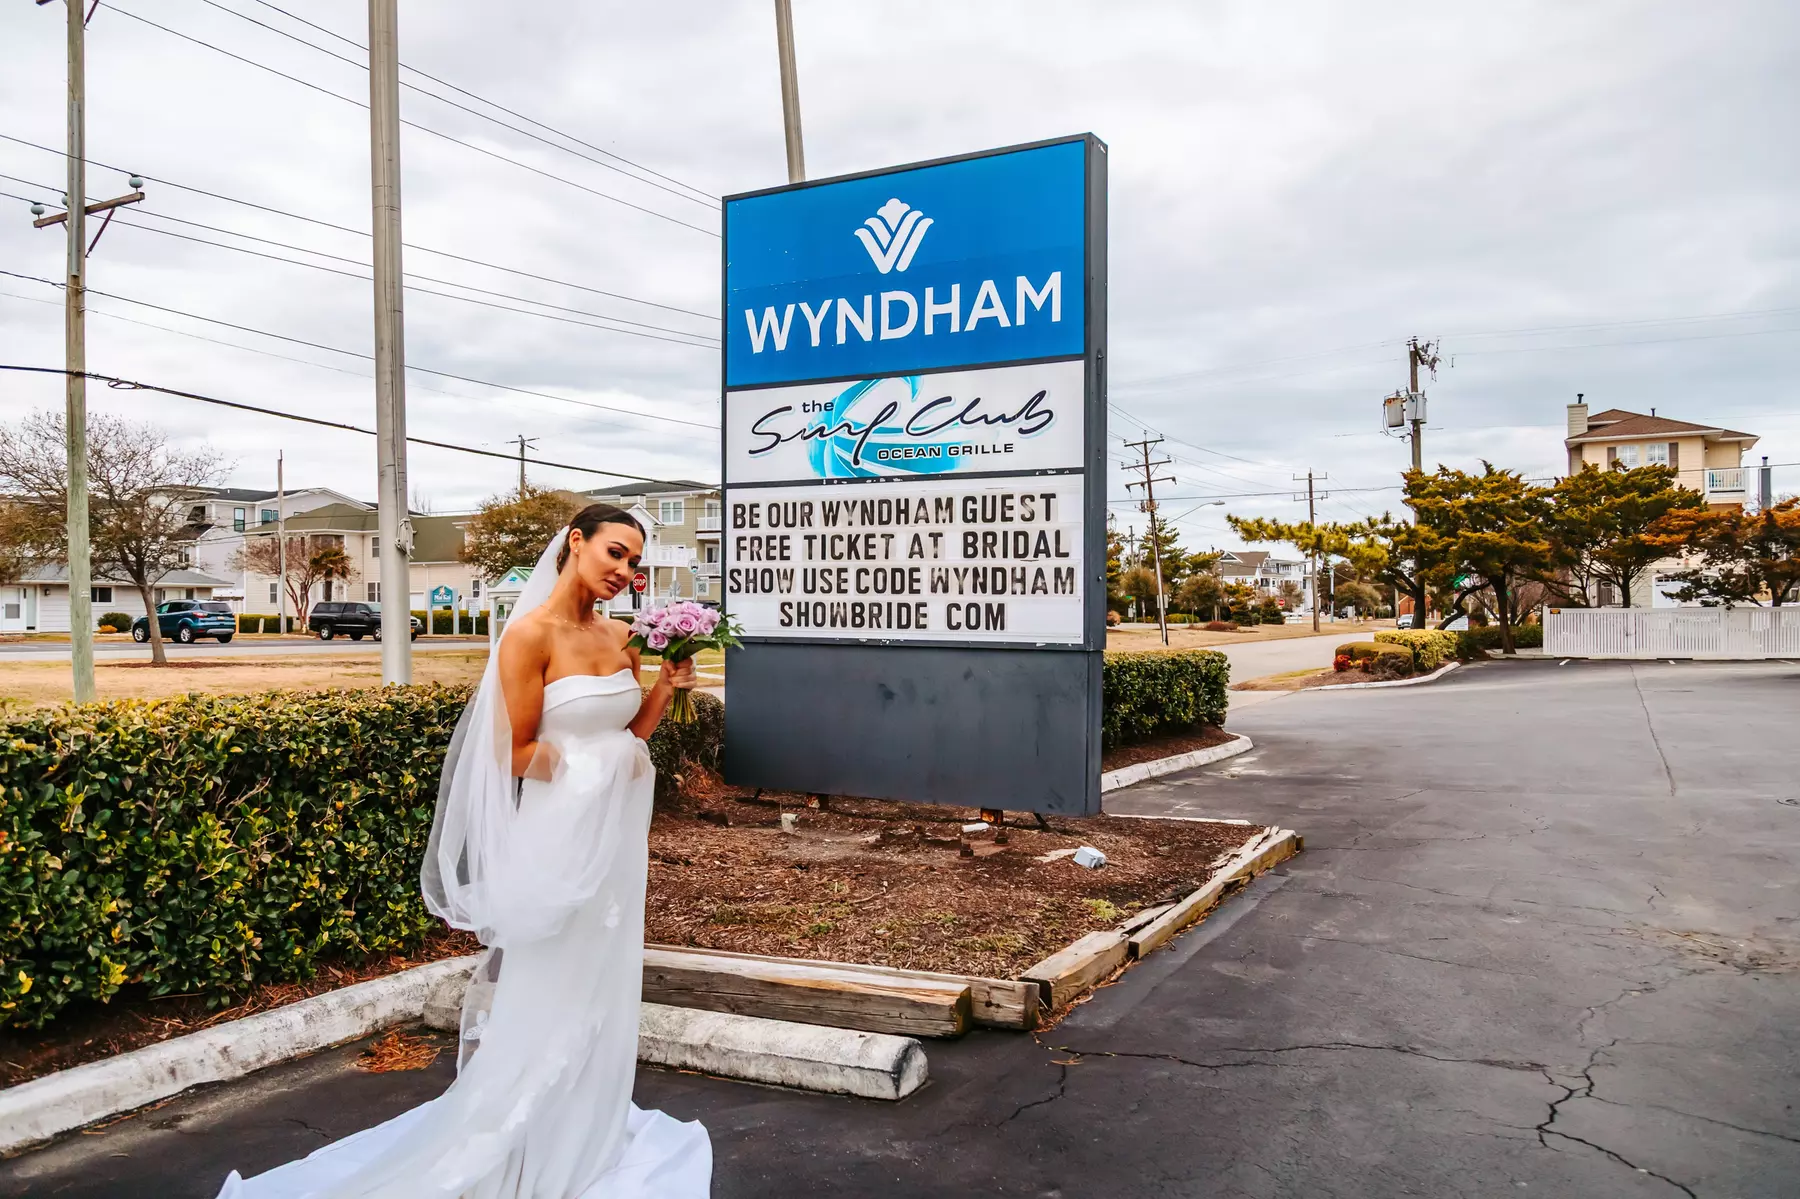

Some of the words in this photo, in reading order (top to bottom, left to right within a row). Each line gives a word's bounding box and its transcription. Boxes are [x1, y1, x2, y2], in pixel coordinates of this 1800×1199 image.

[745, 271, 1062, 354] WYNDHAM
[802, 400, 834, 414] the
[749, 401, 898, 466] Surf
[906, 389, 1054, 436] Club
[878, 446, 941, 460] OCEAN
[948, 442, 1014, 457] GRILLE
[733, 502, 760, 529] BE
[768, 501, 814, 528] OUR
[821, 496, 954, 527] WYNDHAM
[962, 492, 1057, 523] GUEST
[736, 535, 791, 562] FREE
[804, 533, 895, 561] TICKET
[908, 532, 944, 560] AT
[963, 529, 1070, 559] BRIDAL
[634, 578, 646, 587] STOP
[729, 567, 795, 594] SHOW
[803, 567, 849, 594] USE
[856, 566, 921, 595] CODE
[930, 566, 1075, 595] WYNDHAM
[780, 601, 928, 630] SHOWBRIDE
[946, 602, 1006, 631] COM
